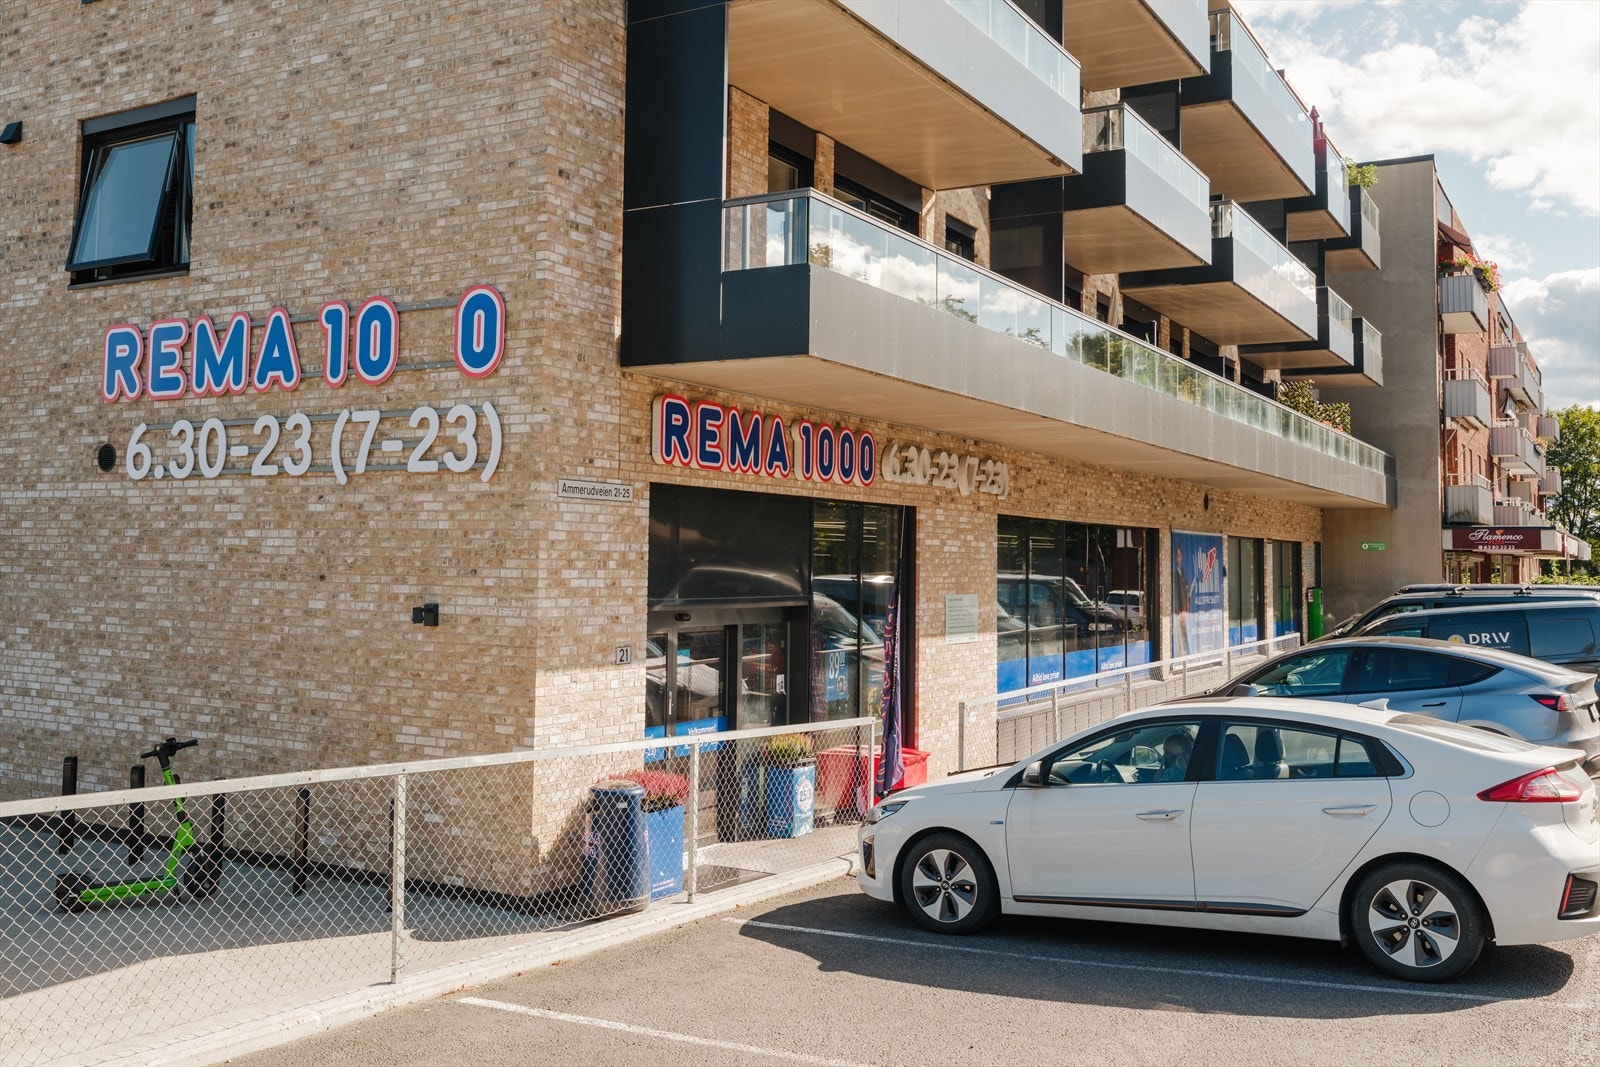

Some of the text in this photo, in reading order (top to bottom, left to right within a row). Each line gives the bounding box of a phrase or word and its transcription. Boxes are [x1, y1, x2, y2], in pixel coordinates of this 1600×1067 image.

[103, 306, 302, 402] REMA
[125, 401, 503, 485] 6.30-23 (7-23)
[660, 393, 876, 487] REMA 1000
[882, 443, 1009, 500] 6.30-23 (7-23)
[562, 482, 631, 499] Ammerudveien 21-25
[1468, 529, 1524, 541] Flamenco
[619, 650, 629, 663] 21
[828, 653, 840, 679] 89
[687, 724, 716, 736] Velkommen!
